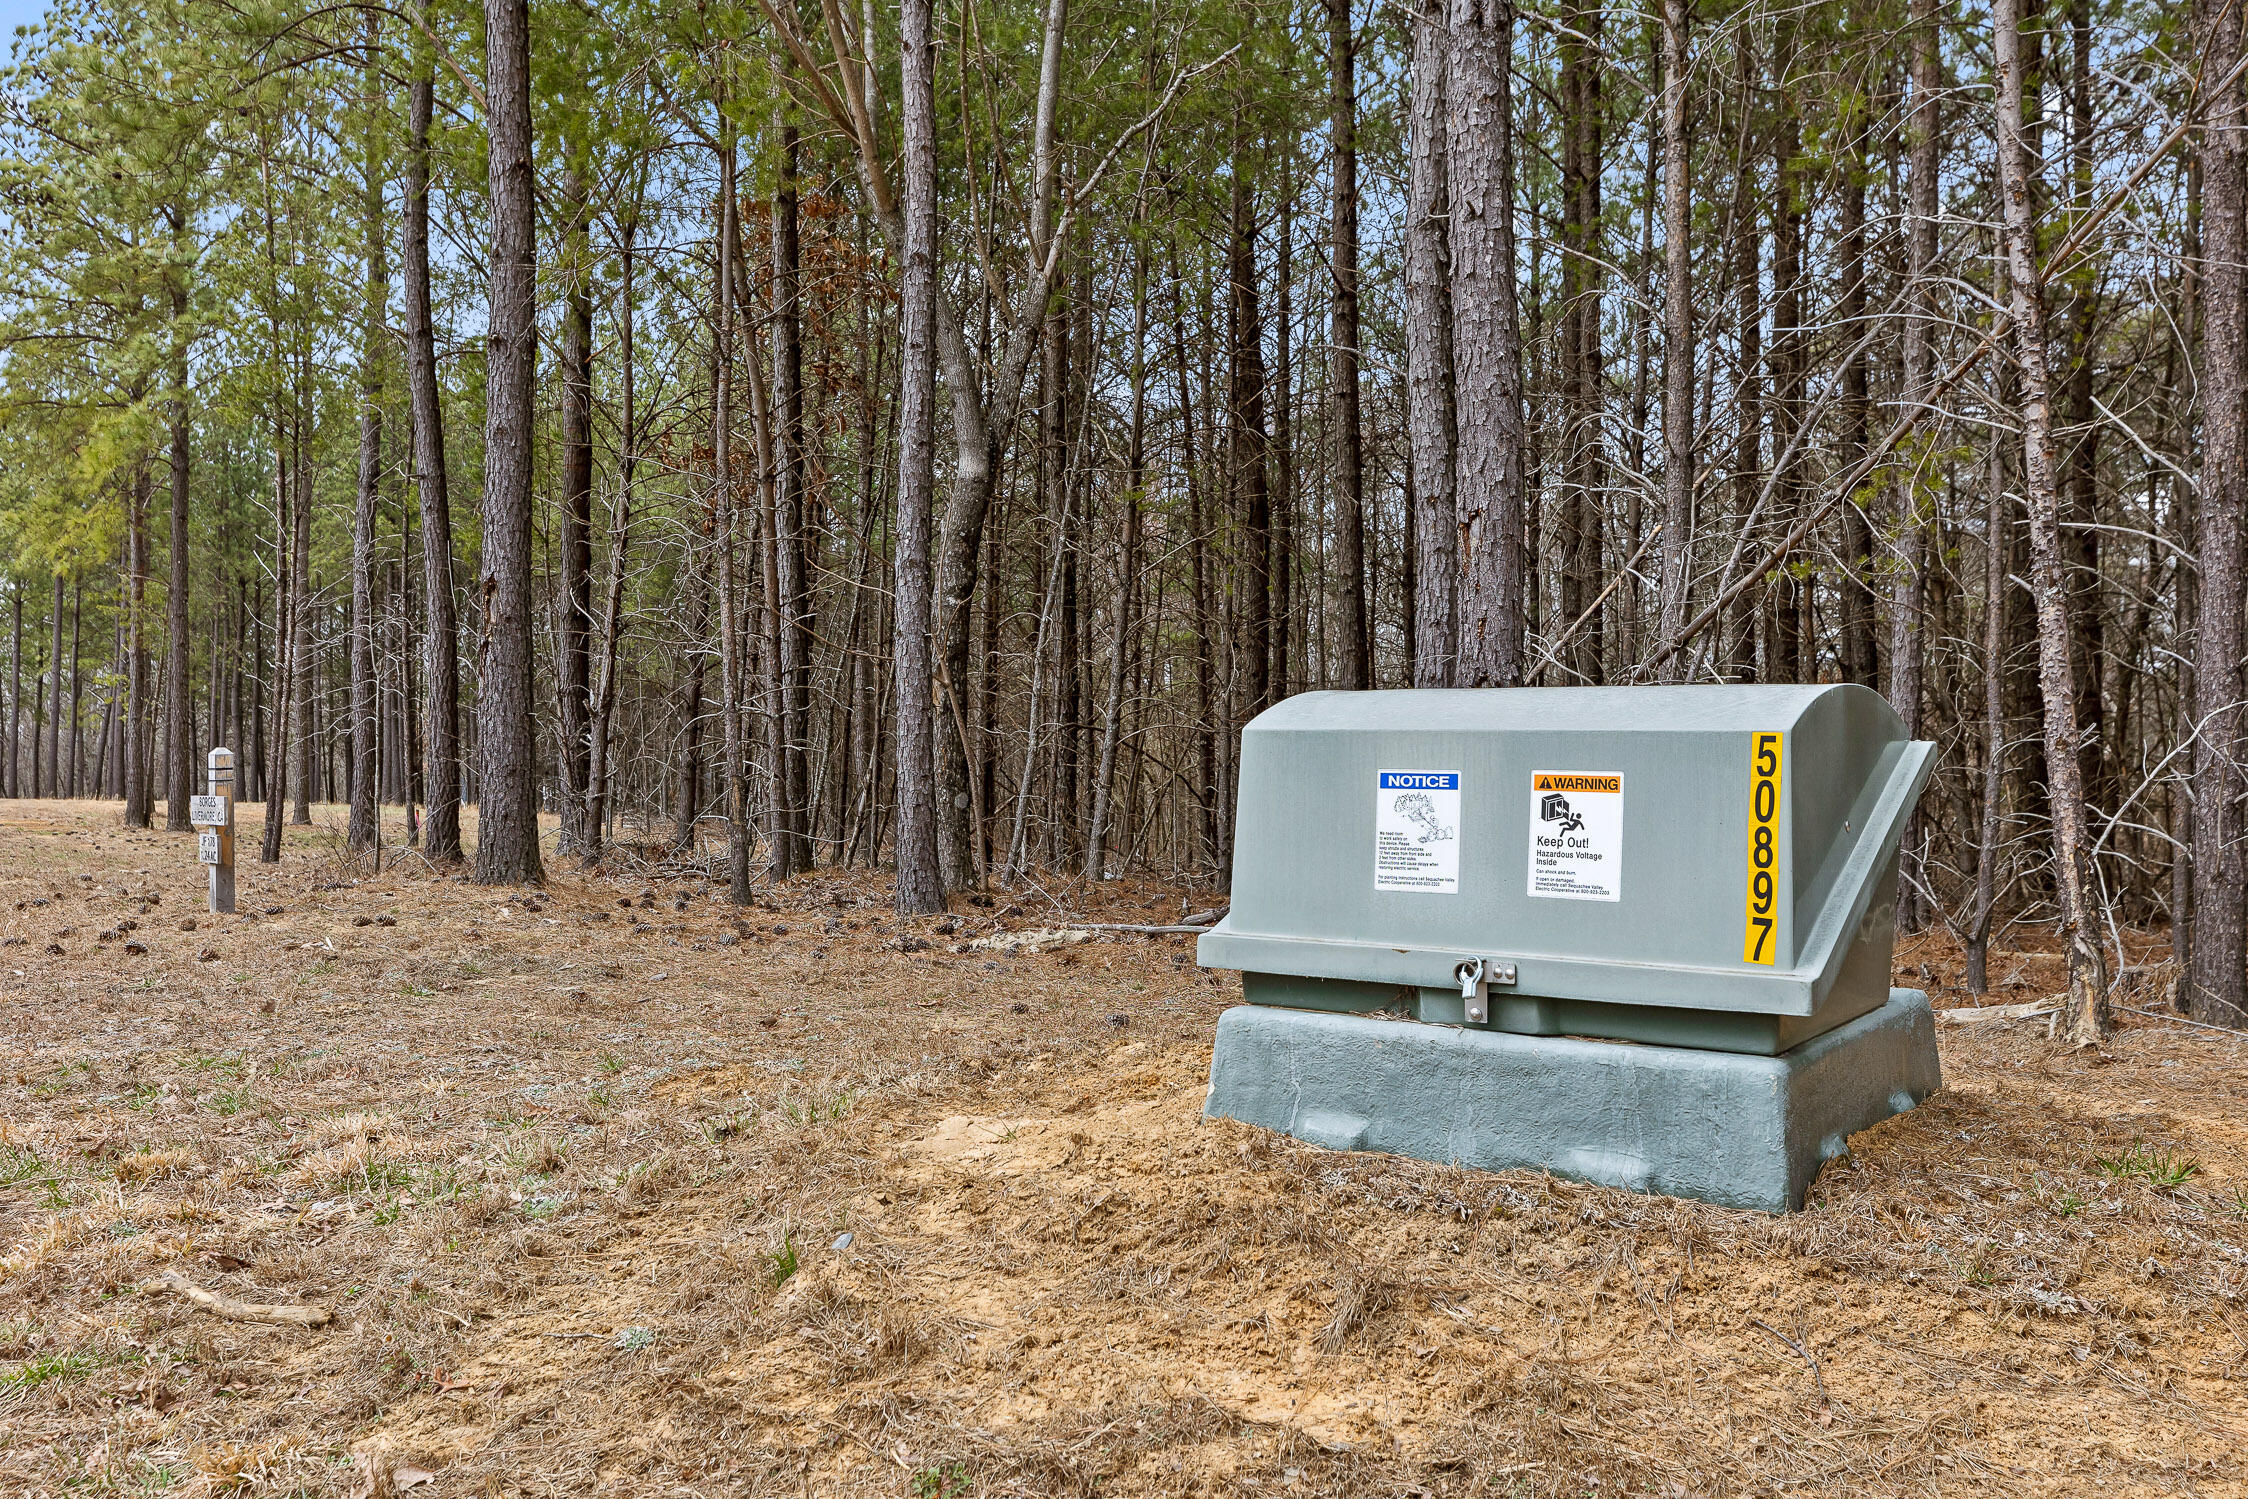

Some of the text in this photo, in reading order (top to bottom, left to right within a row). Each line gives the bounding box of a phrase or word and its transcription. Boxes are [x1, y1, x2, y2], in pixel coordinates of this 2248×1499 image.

[1388, 775, 1450, 788] NOTICE
[1554, 778, 1618, 790] WARNING
[200, 797, 216, 807] BORGES
[1537, 836, 1589, 849] Keep Out!
[1752, 735, 1777, 962] 50897
[1537, 850, 1602, 861] Hazardous Voltage
